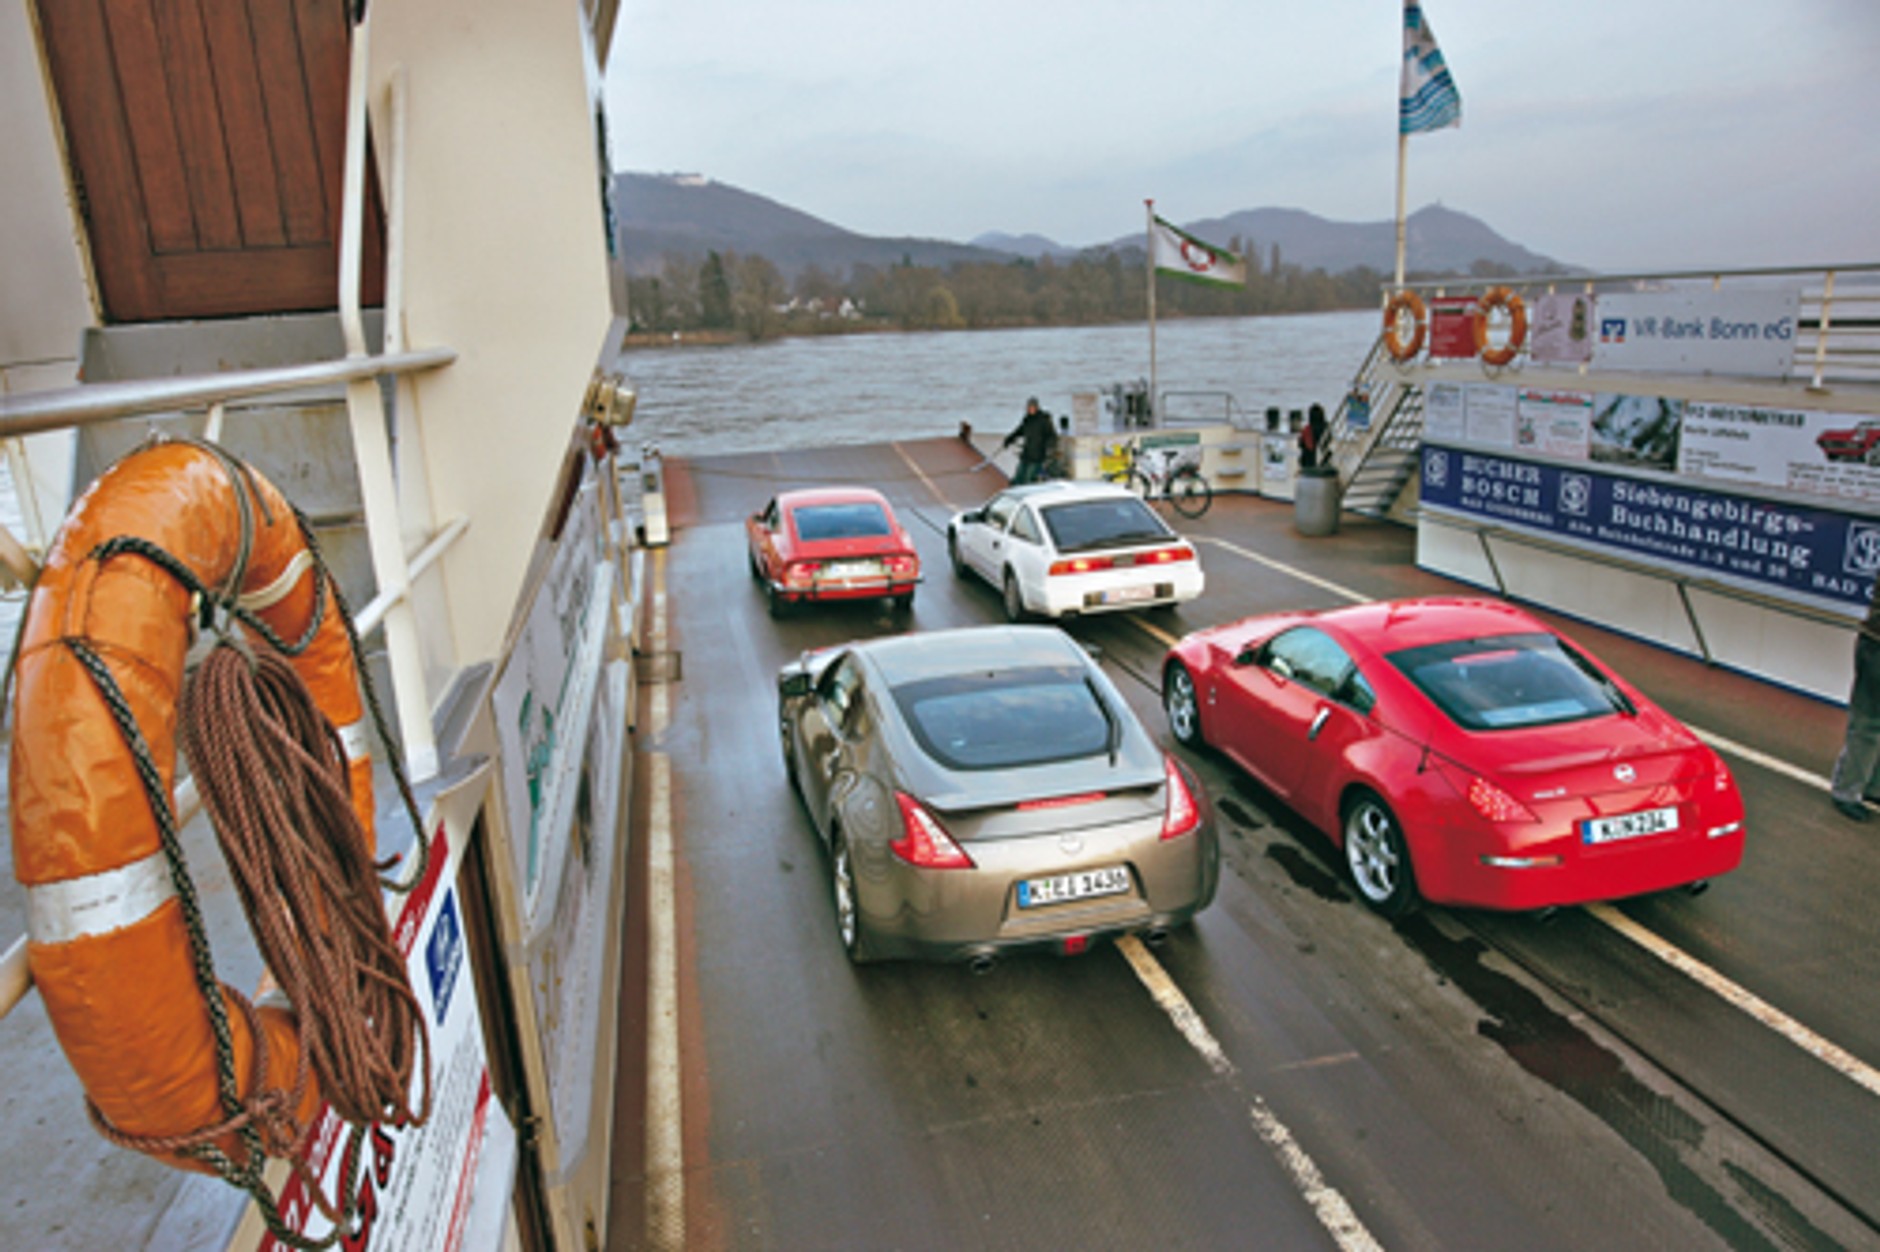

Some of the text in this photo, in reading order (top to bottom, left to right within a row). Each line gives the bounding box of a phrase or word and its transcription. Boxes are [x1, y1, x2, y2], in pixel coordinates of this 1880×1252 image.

[1633, 316, 1791, 339] VR-Bank Bonn eG
[1461, 476, 1540, 507] BOSCH
[1612, 482, 1814, 534] Siebengebirgs-
[1612, 505, 1812, 567] Buchhandlung
[1730, 558, 1761, 572] und
[1813, 574, 1858, 595] BAD
